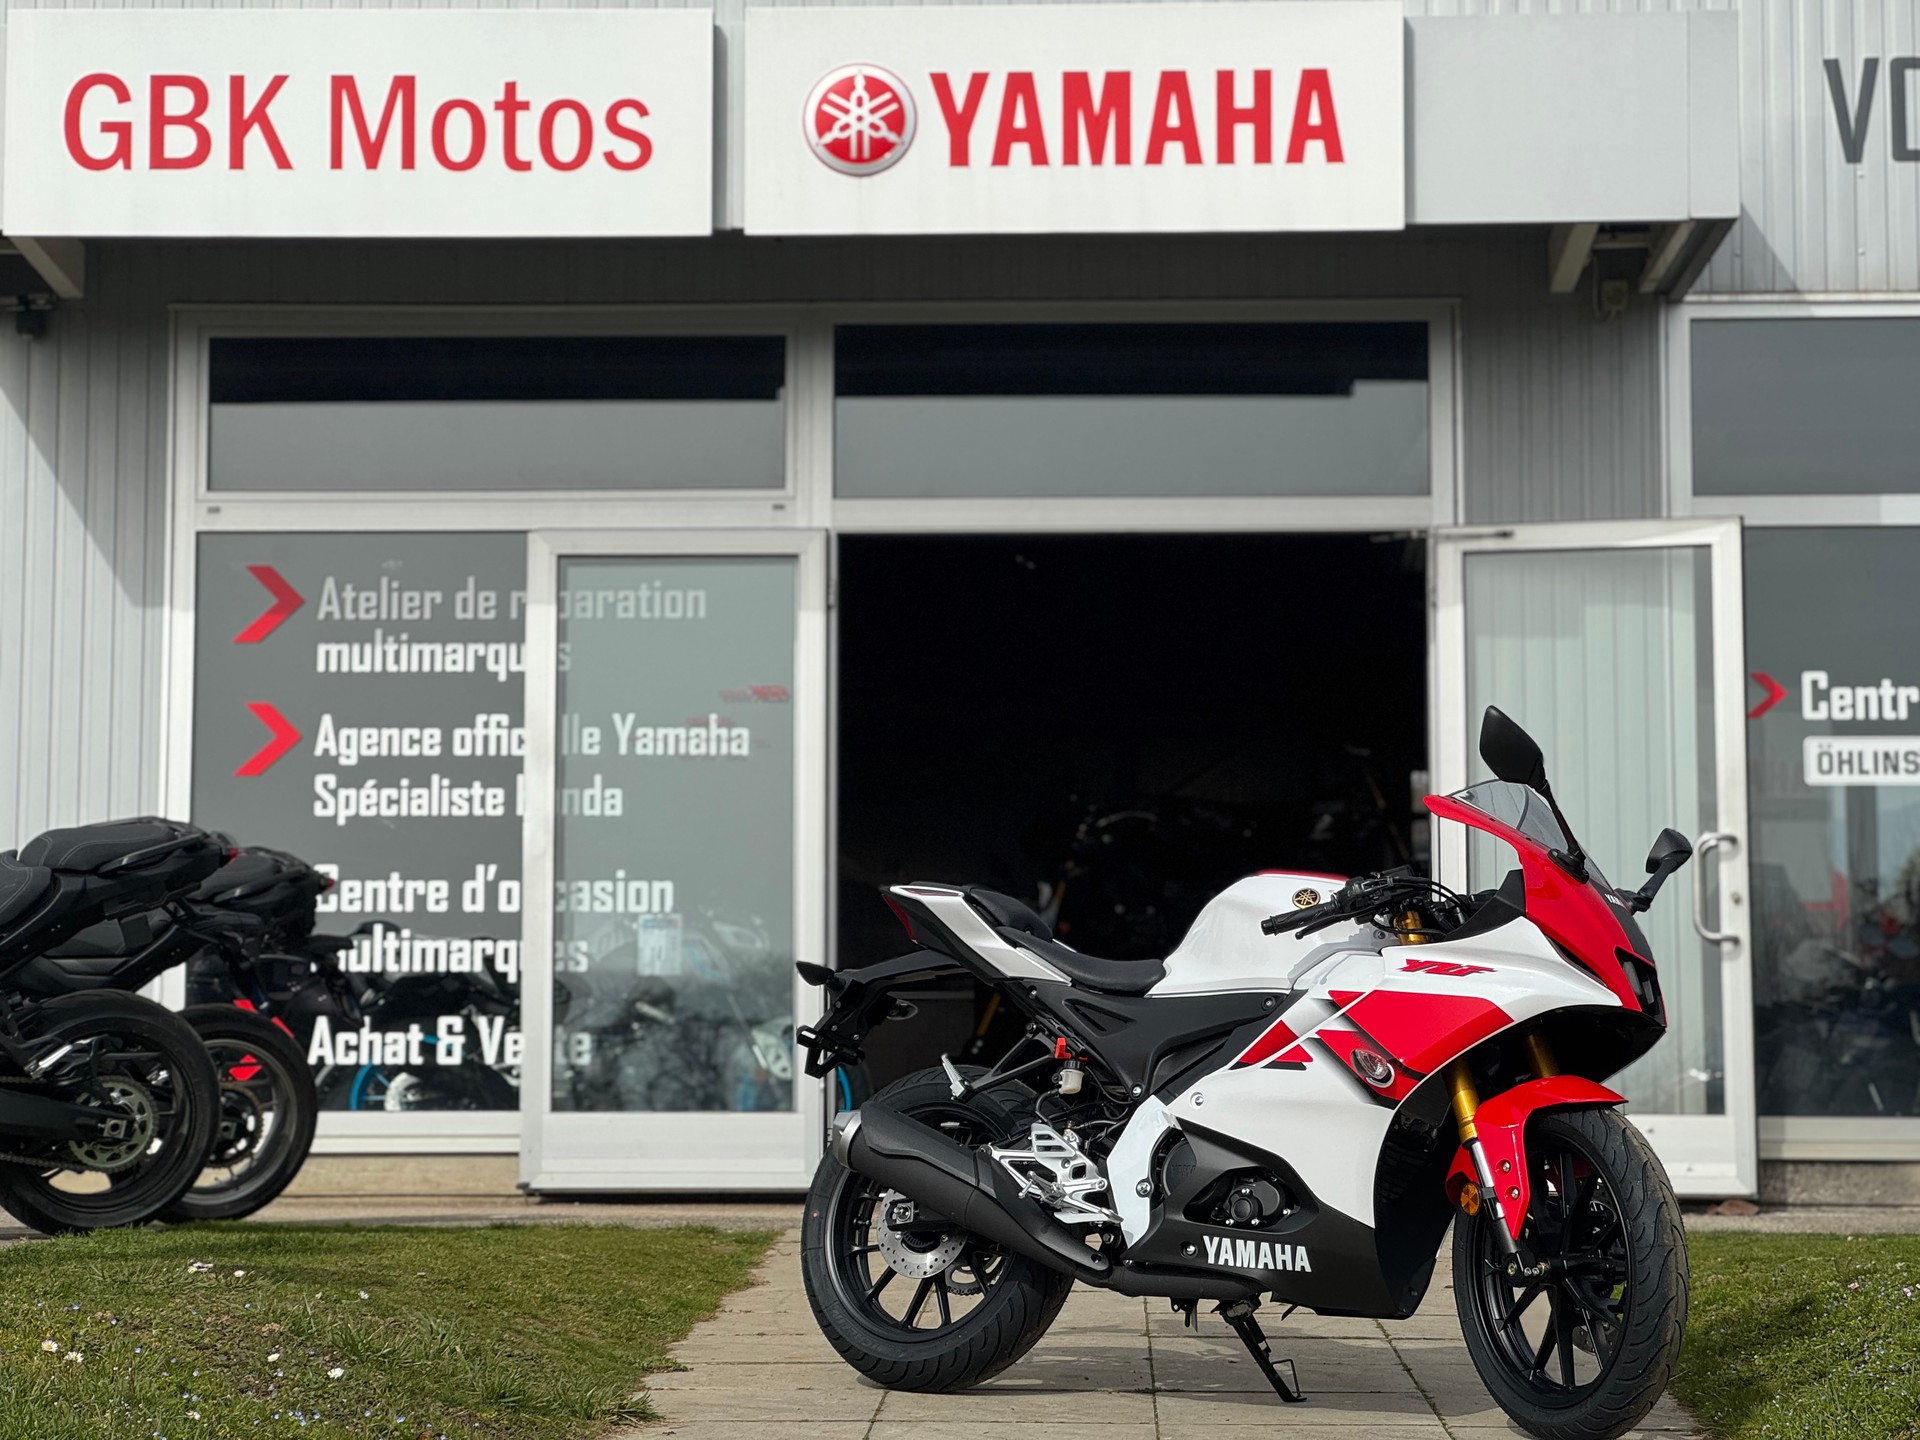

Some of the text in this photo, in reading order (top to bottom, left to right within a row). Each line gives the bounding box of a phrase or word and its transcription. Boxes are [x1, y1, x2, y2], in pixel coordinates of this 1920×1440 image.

[63, 73, 653, 171] GBK Motos
[929, 69, 1345, 167] YAMAHA
[317, 576, 706, 620] Atelier de raration
[316, 628, 572, 682] multimarqus
[1801, 670, 1920, 720] Centr
[313, 712, 749, 766] Agence officlle Yamaha
[1817, 743, 1920, 775] ÖHLINS
[313, 773, 623, 826] Spécialiste nda
[310, 923, 589, 984] ultimarqs
[307, 1015, 592, 1065] Achat & Vete
[1203, 1235, 1312, 1273] YAMAHA
